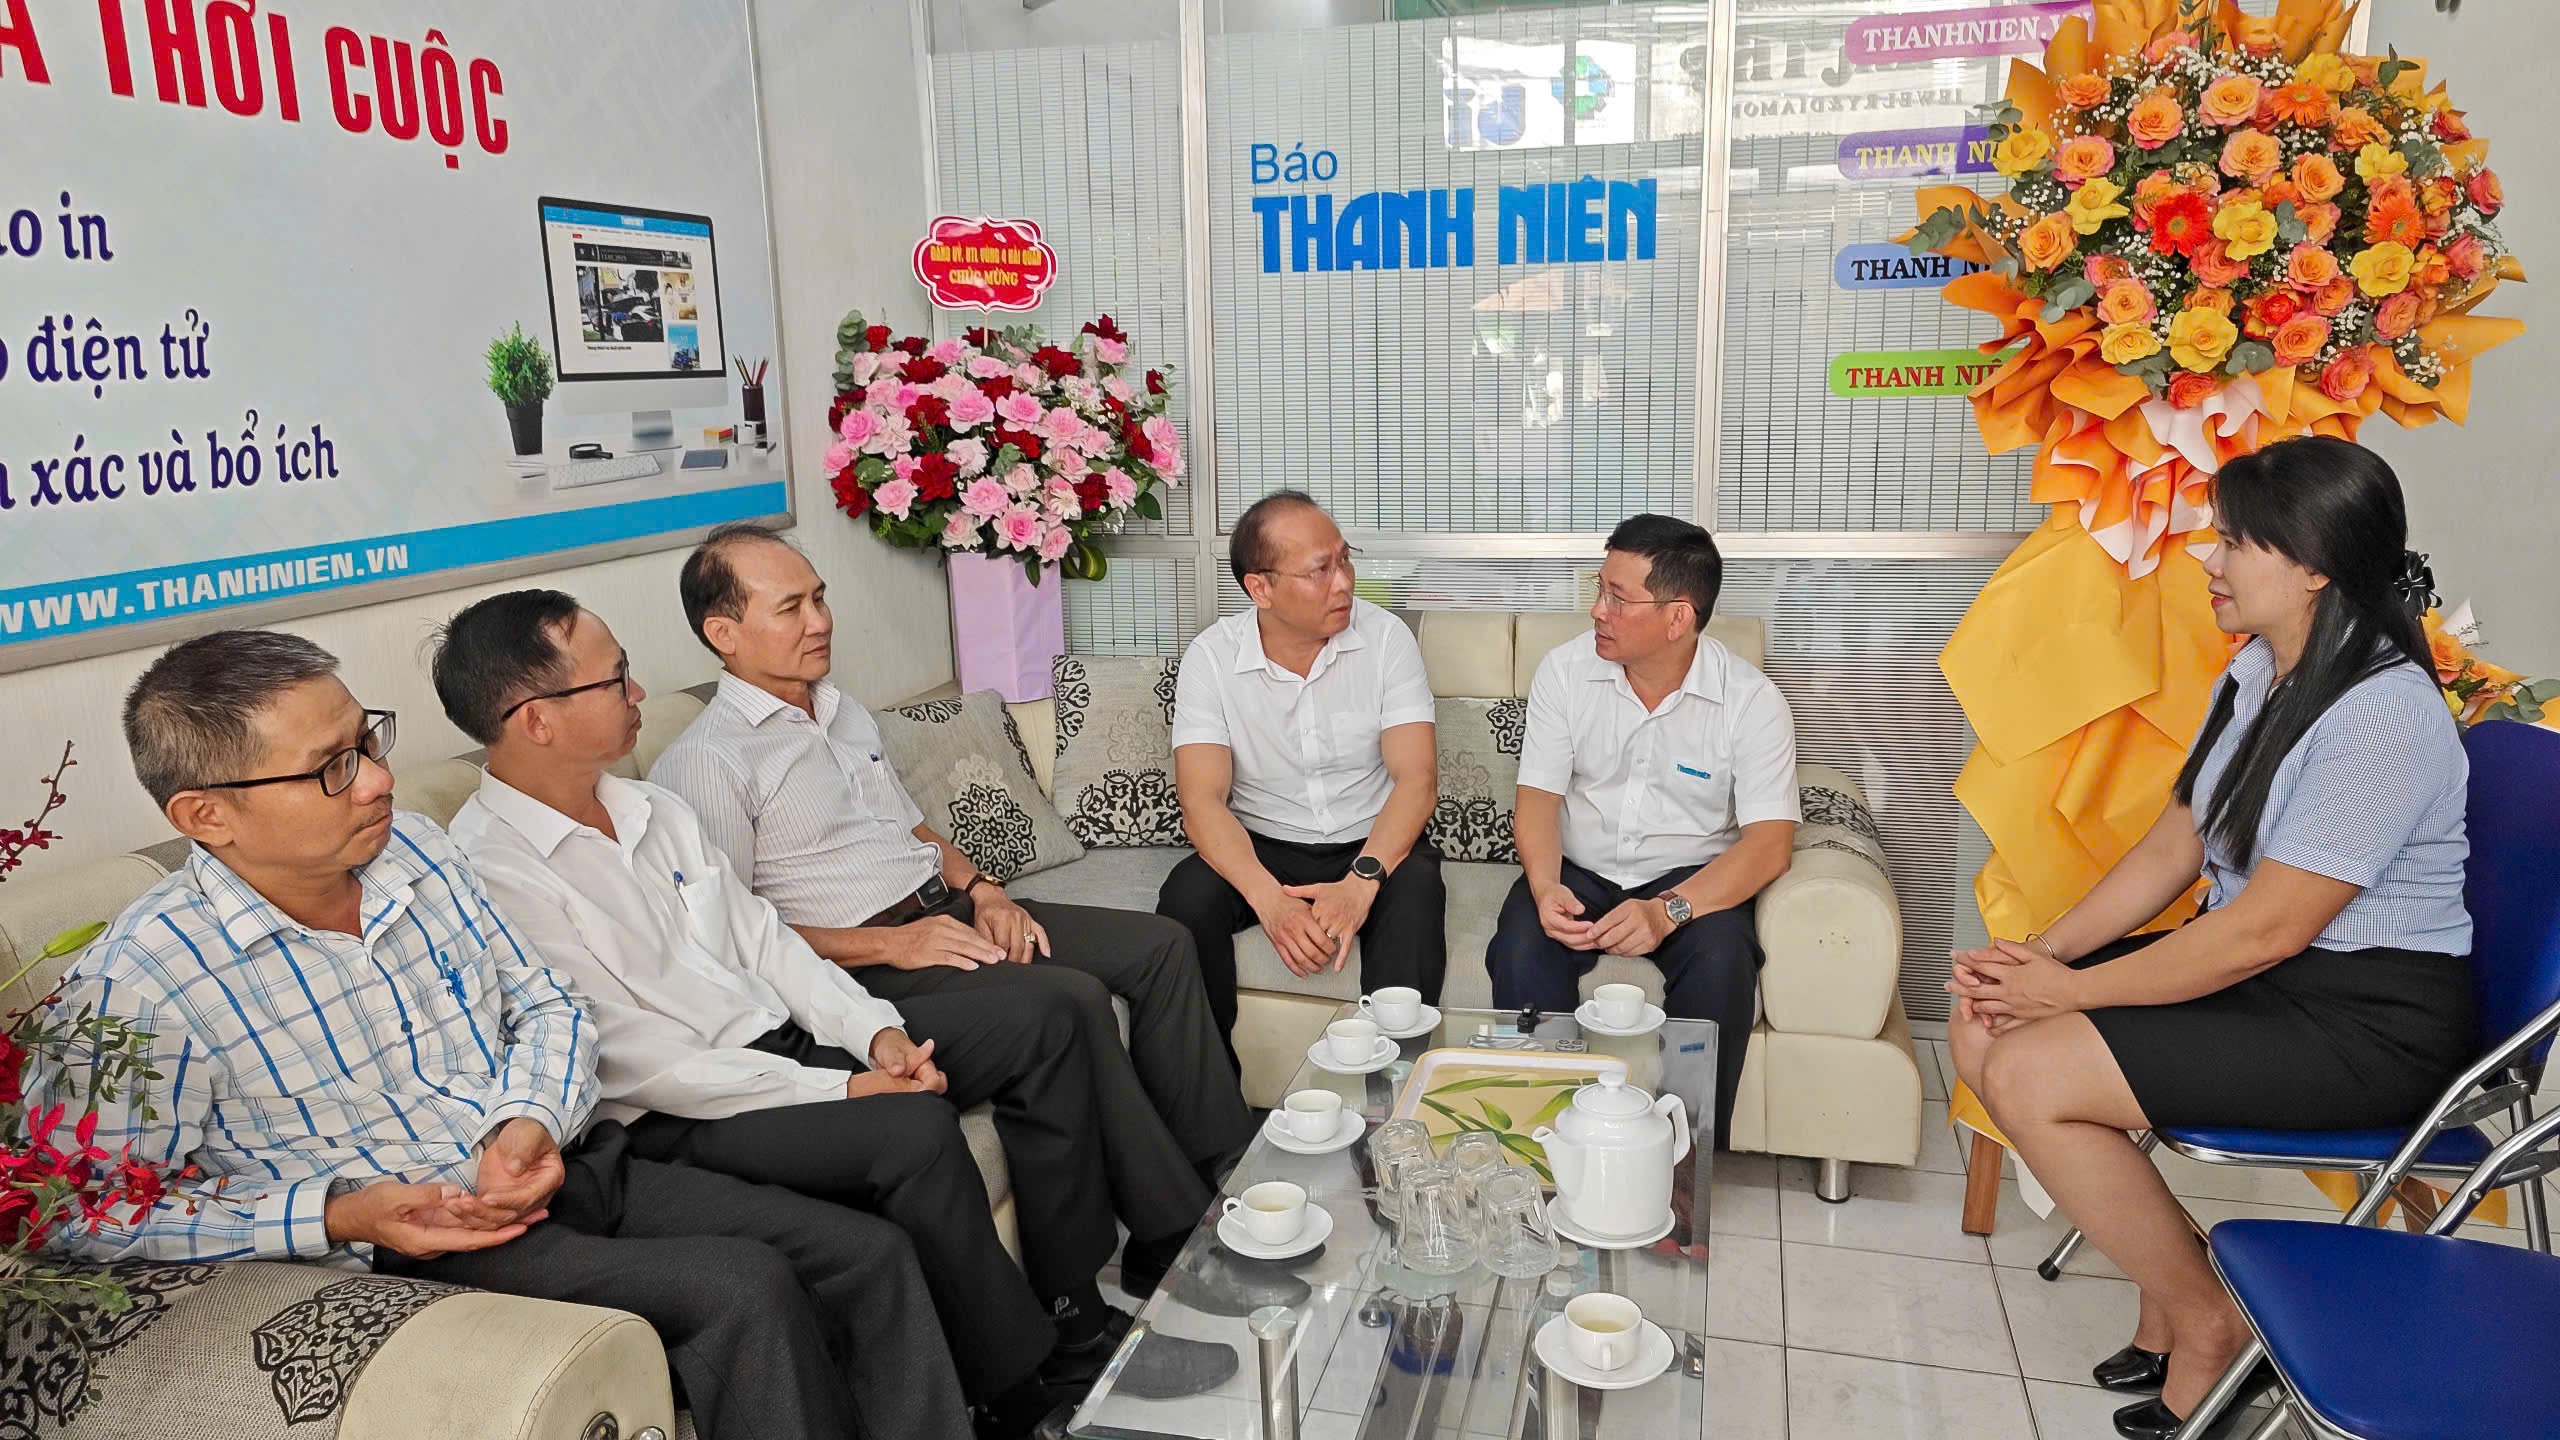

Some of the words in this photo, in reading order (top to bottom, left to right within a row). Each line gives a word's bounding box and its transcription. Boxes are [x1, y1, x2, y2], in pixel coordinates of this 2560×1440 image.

[324, 26, 509, 170] CUỘC
[1250, 142, 1339, 184] Báo
[1855, 142, 1957, 170] THANH
[58, 190, 114, 261] in
[1252, 189, 1475, 273] THANH
[1497, 174, 1657, 265] NIÊN
[1850, 256, 1952, 281] THANH
[26, 313, 148, 399] điện
[159, 308, 211, 379] tử
[1846, 365, 1945, 388] THANH
[30, 433, 126, 507] xác
[138, 428, 197, 496] và
[206, 408, 262, 489] bổ
[275, 423, 339, 483] ích
